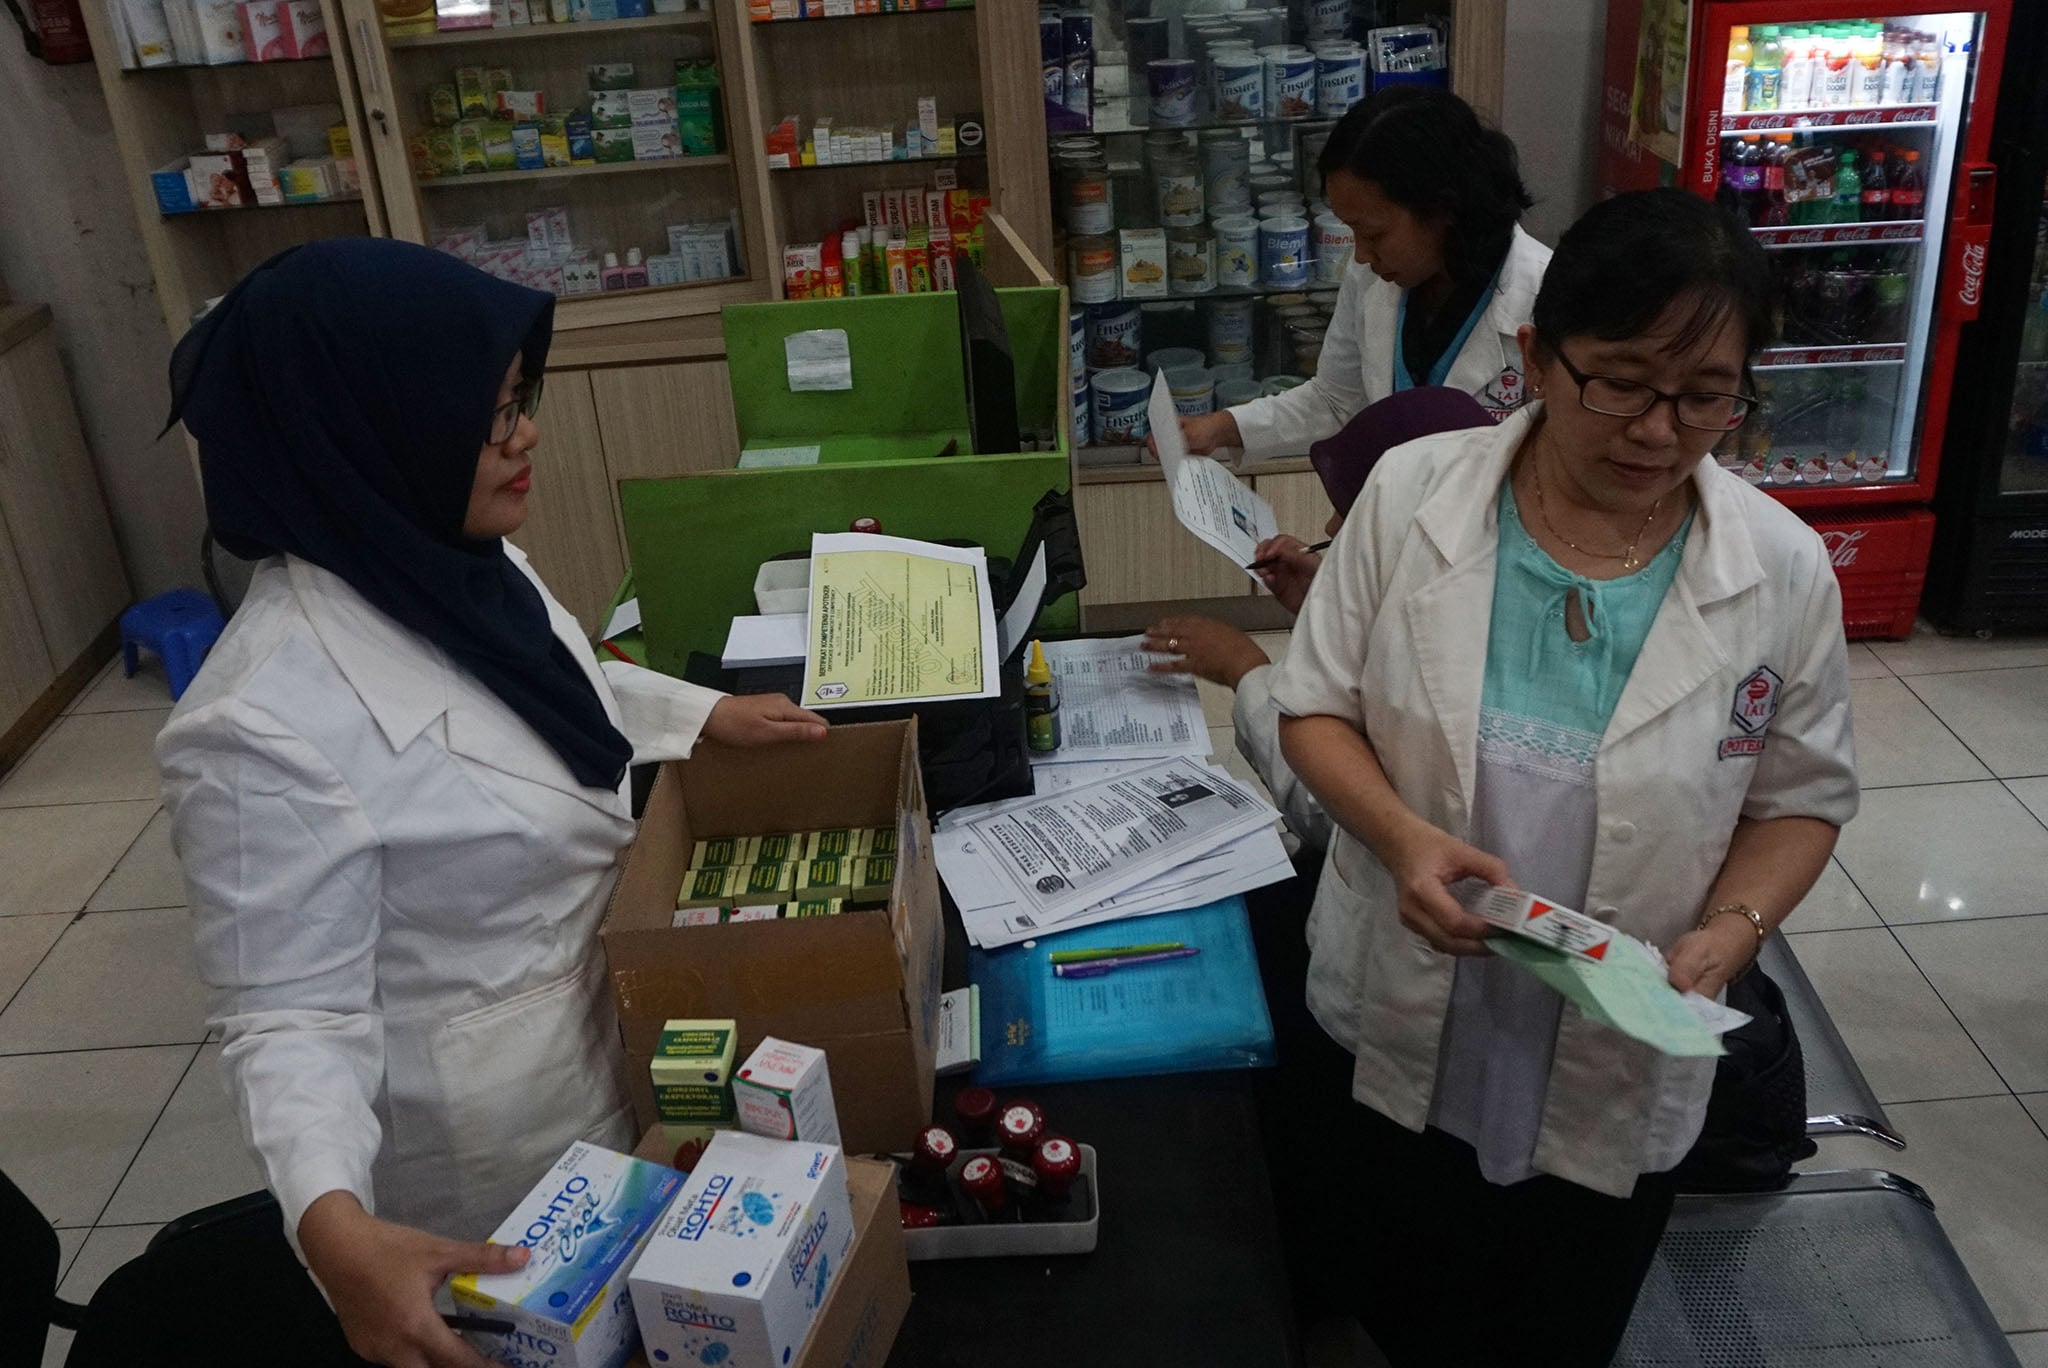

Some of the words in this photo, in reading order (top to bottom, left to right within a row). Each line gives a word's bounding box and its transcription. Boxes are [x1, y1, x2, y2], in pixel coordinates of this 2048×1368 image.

[1706, 110, 1720, 146] DISINI
[1703, 148, 1716, 183] BUKA
[867, 198, 878, 226] CREAM
[889, 197, 899, 225] CREAM
[912, 196, 920, 224] CREAM
[932, 199, 940, 226] CREAM
[1293, 248, 1302, 268] 1
[1959, 242, 1985, 305] Coca-Cola
[822, 584, 830, 613] APOTEKER
[1744, 703, 1767, 718] IAI
[994, 824, 1022, 854] KESEHATAN
[1020, 854, 1039, 875] DINAS
[557, 1146, 586, 1171] Steril
[515, 1176, 589, 1248] ROHTO
[666, 1214, 684, 1238] Obat
[680, 1194, 698, 1216] Mata
[677, 1174, 727, 1241] ROHTO
[559, 1192, 601, 1263] Cool
[791, 1210, 828, 1285] ROHTO
[664, 1306, 736, 1330] ROHTO
